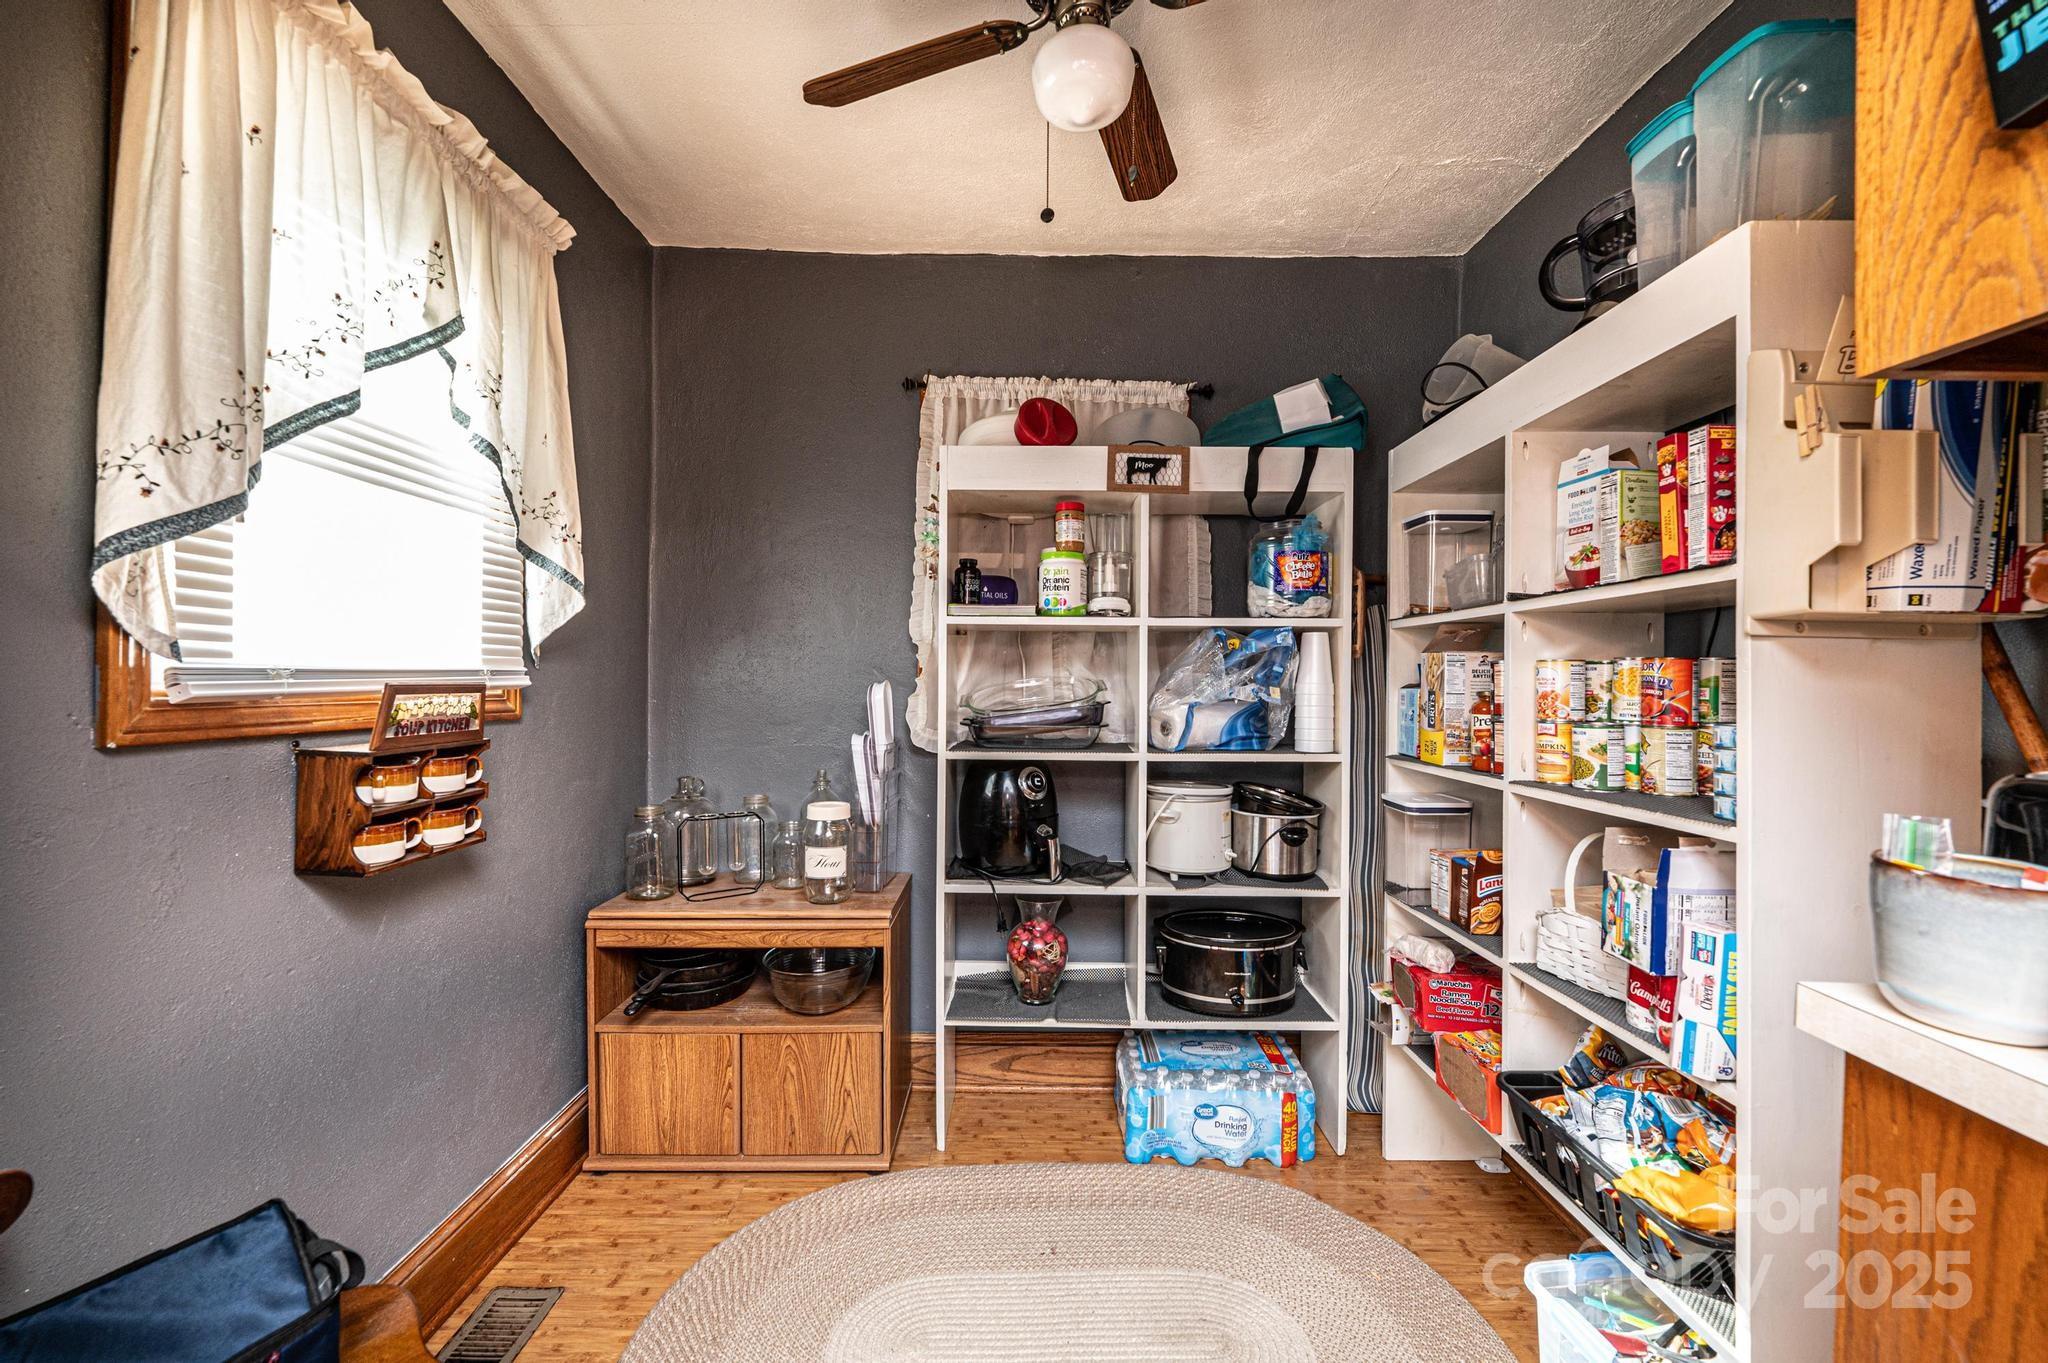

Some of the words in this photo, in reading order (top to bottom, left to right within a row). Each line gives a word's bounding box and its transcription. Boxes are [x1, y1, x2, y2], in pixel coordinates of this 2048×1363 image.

[1135, 460, 1154, 470] Moo
[1974, 497, 1986, 536] Paper
[1970, 536, 1981, 580] Waxed
[1285, 560, 1315, 571] Cheese
[994, 592, 1008, 600] OILS
[394, 720, 424, 736] SOUP
[425, 716, 471, 734] KITCHEN
[809, 854, 842, 868] Flour
[1633, 895, 1642, 921] Instant
[1437, 980, 1472, 989] Maruchan
[1441, 990, 1470, 999] Ramen
[1700, 974, 1716, 1011] Cheerios
[1430, 995, 1460, 1005] Noodle
[1460, 999, 1481, 1008] Soup
[1453, 1008, 1475, 1016] Flavor
[1283, 1101, 1297, 1113] 40
[1214, 1120, 1248, 1131] Drinking
[1224, 1129, 1247, 1138] Water
[1283, 1127, 1291, 1153] PACK
